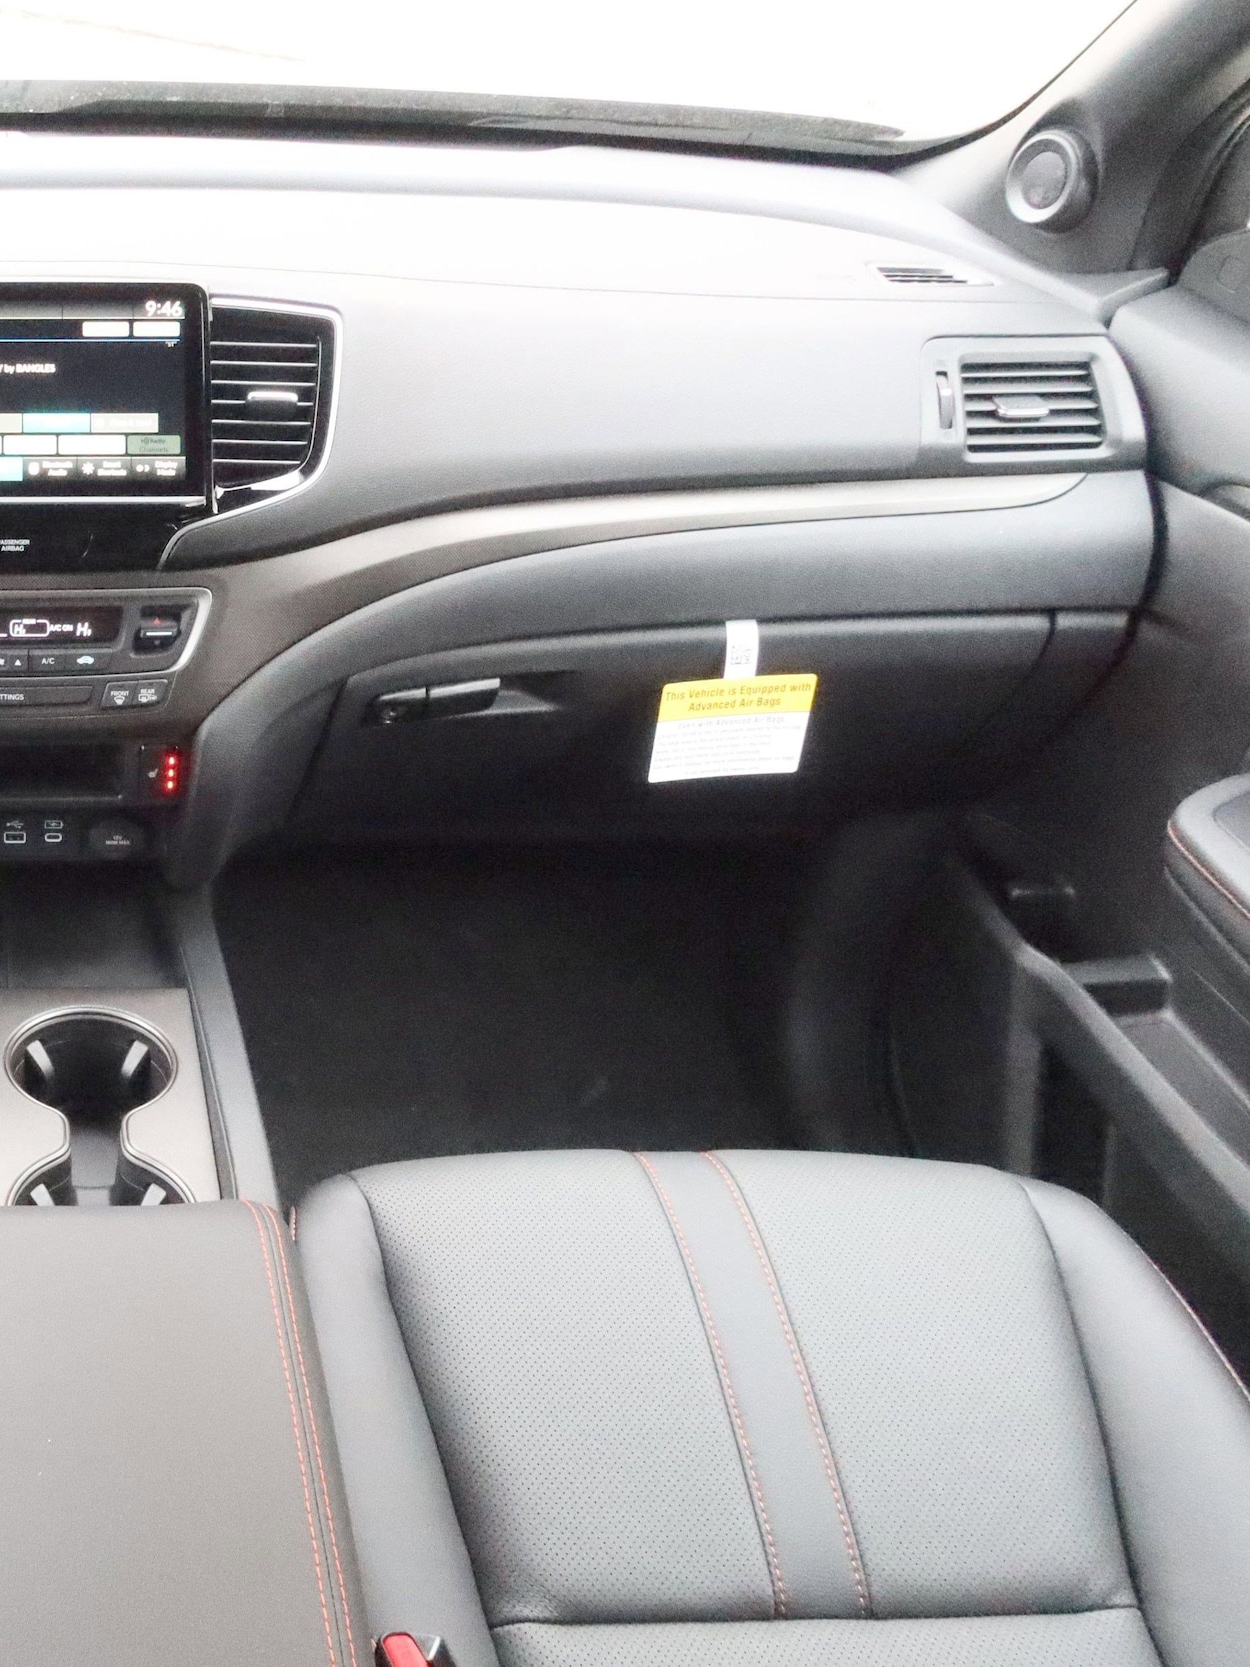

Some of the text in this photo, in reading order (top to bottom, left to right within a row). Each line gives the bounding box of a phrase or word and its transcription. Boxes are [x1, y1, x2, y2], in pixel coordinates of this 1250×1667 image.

[145, 300, 183, 317] 9:46
[3, 364, 15, 375] by
[16, 364, 56, 374] BANGLES
[41, 657, 55, 665] A/C
[665, 682, 812, 701] This Vehicle is Equipped with
[687, 696, 782, 712] Advanced Air Bags
